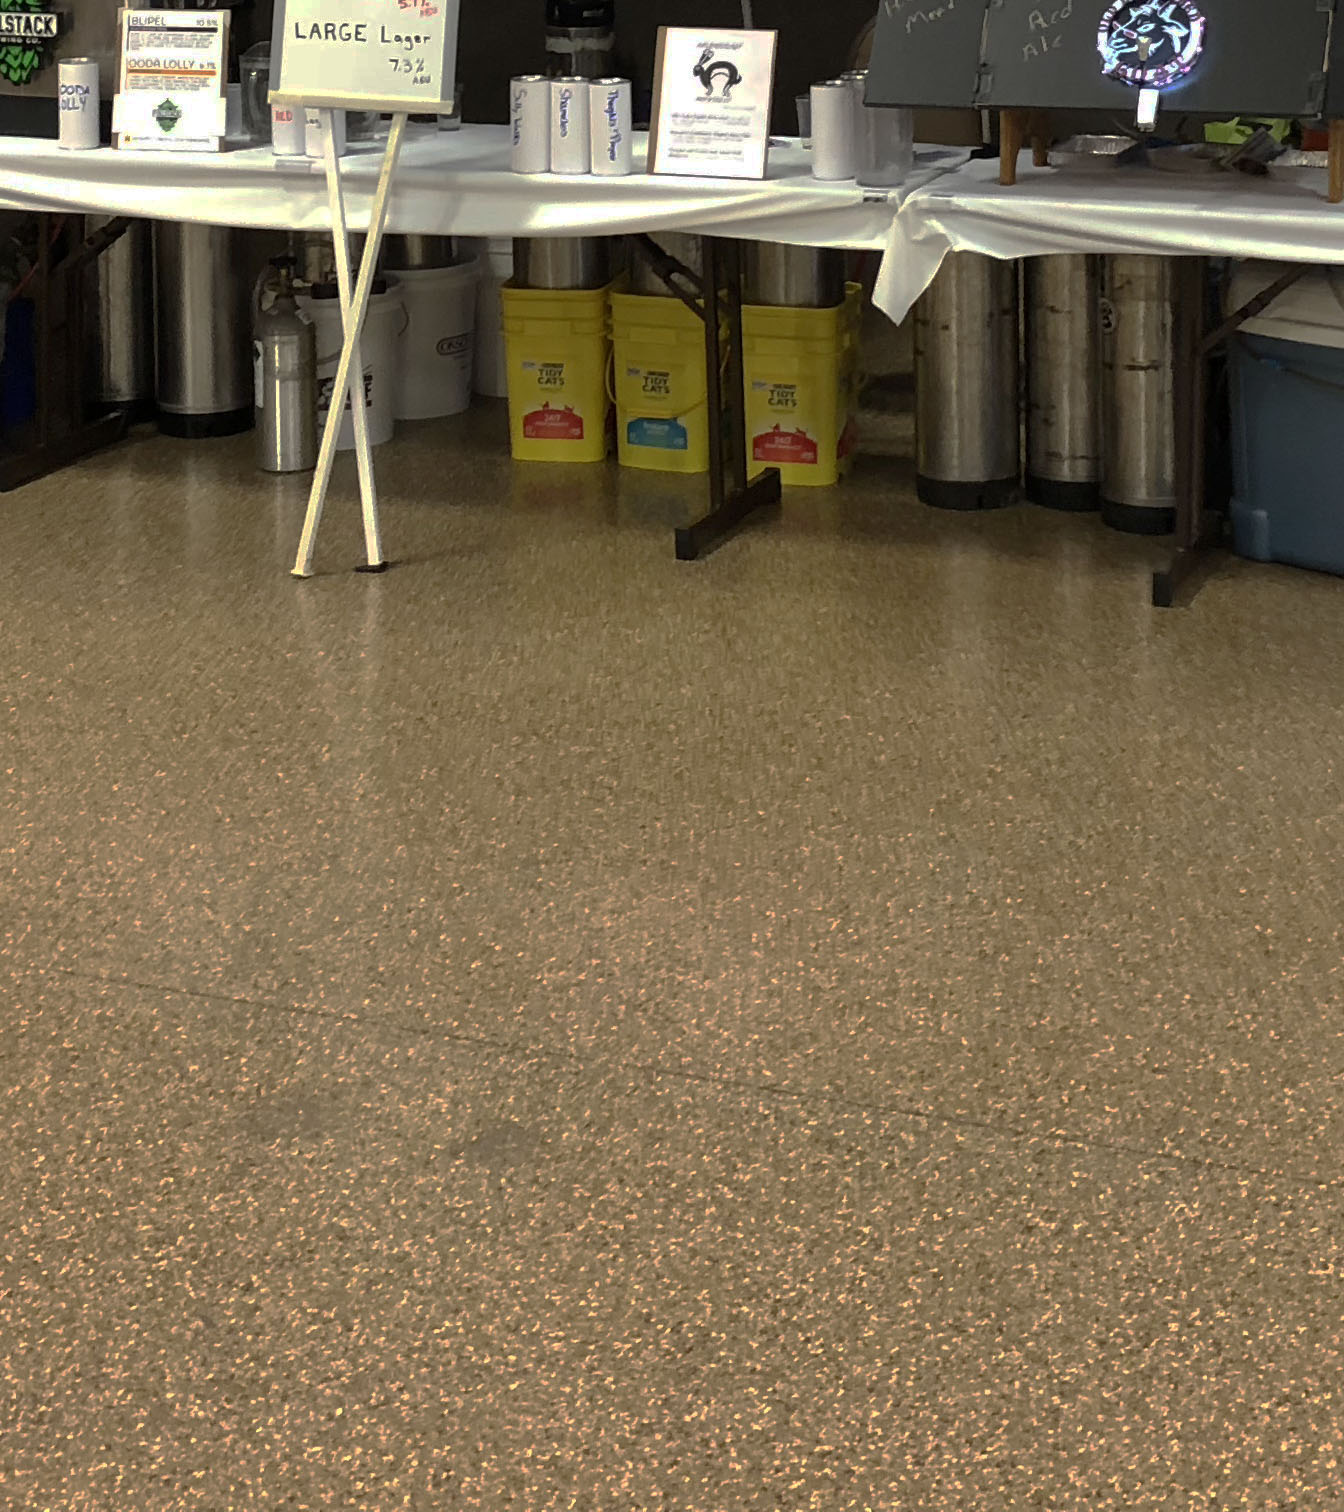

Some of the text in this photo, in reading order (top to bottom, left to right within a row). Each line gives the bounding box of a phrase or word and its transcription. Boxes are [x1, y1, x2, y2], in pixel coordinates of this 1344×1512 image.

[294, 22, 431, 51] LARGE Lager
[388, 58, 425, 73] 7.3%
[537, 368, 564, 377] TIDY
[537, 376, 565, 386] CATS
[642, 384, 670, 394] CATS
[768, 397, 798, 407] CATS
